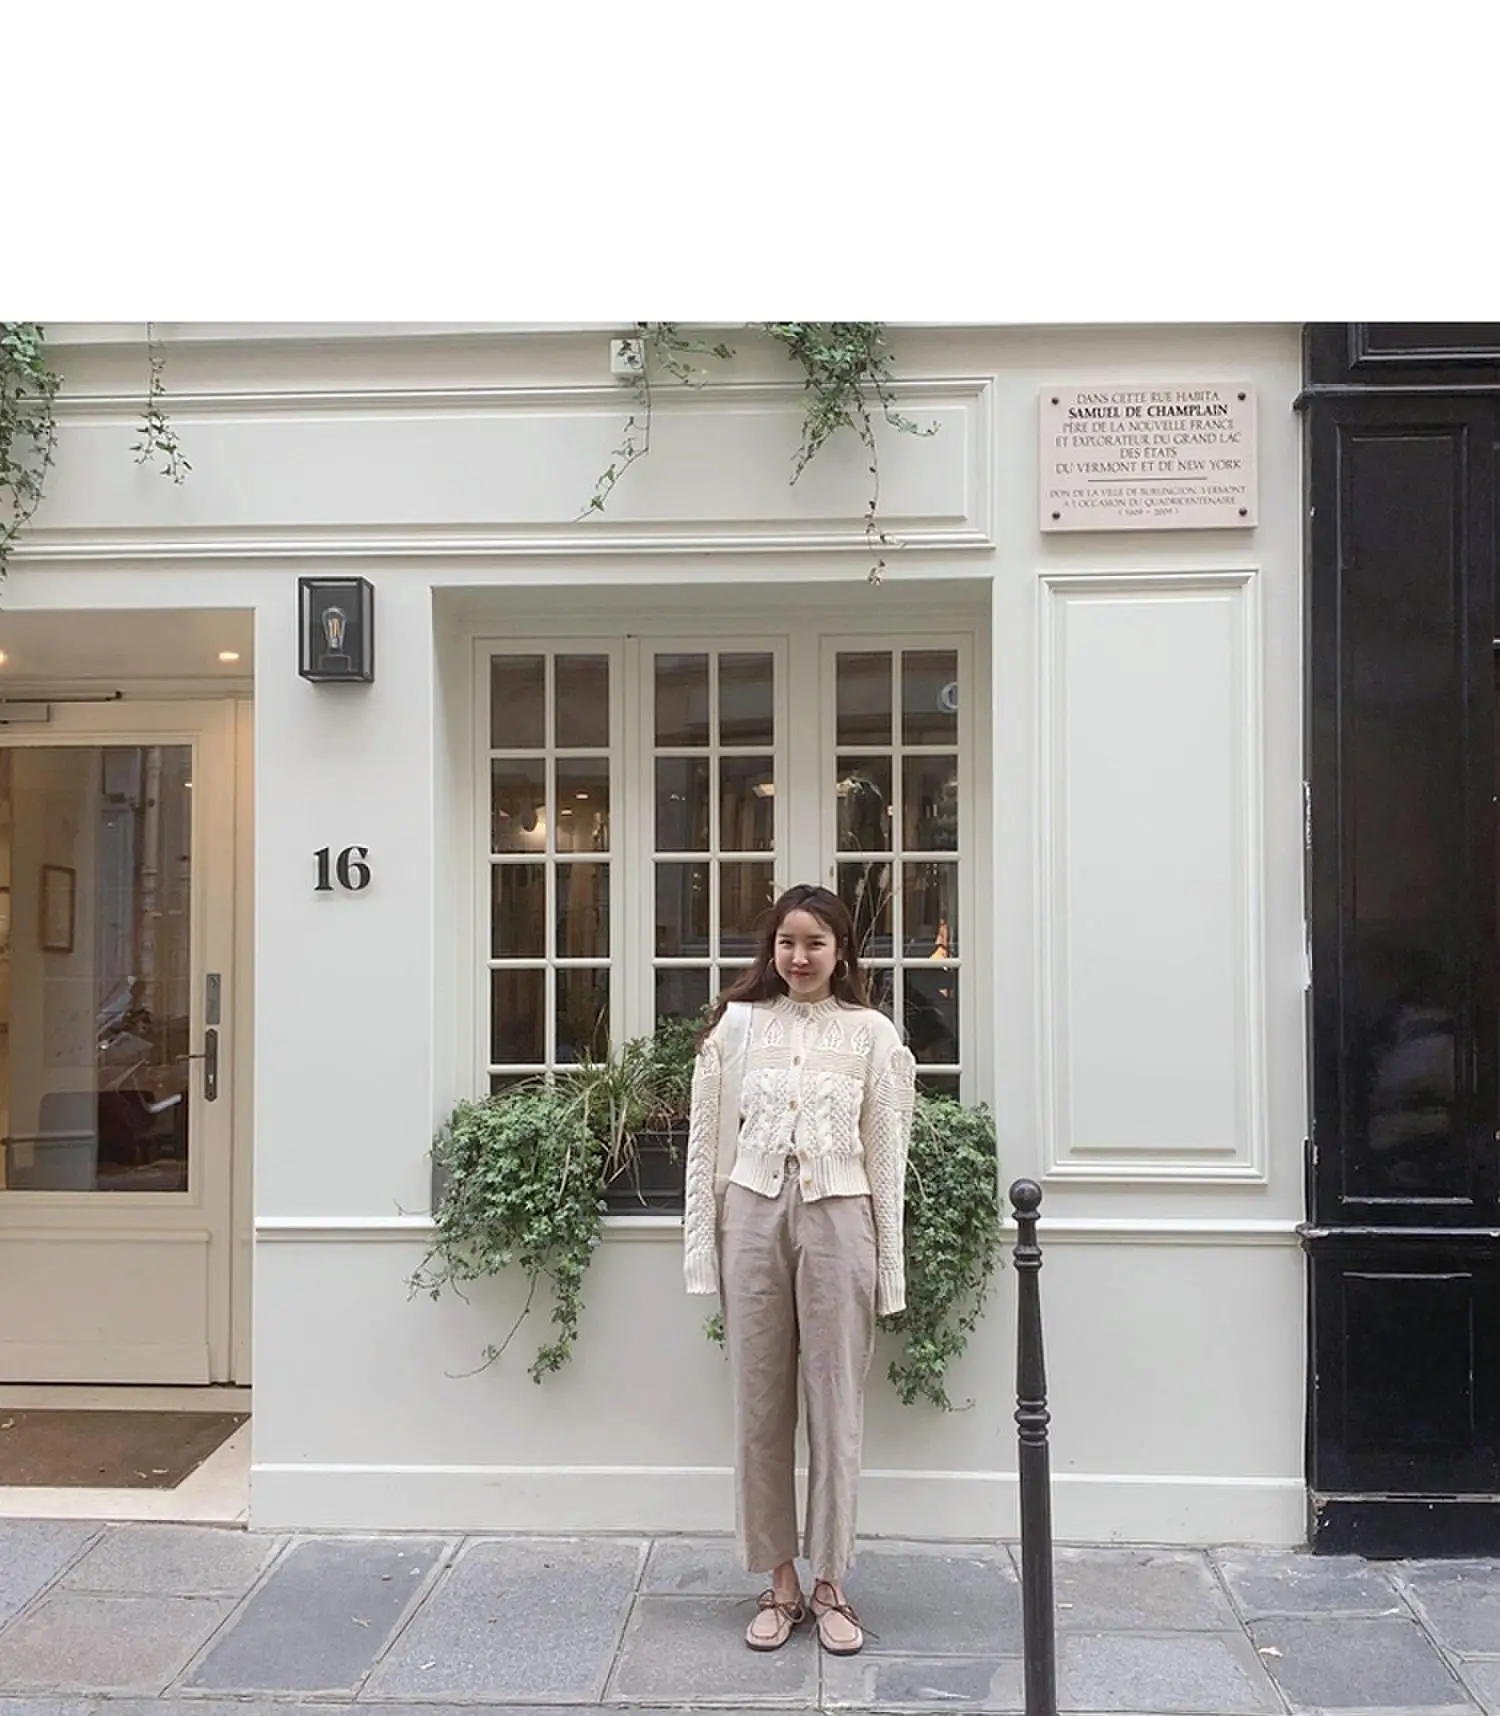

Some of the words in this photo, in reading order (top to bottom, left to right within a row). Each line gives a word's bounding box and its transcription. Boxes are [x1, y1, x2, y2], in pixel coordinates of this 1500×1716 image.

[1068, 407, 1120, 418] SAMUEL
[1125, 406, 1142, 417] DE
[1147, 404, 1228, 417] CHAMPLAIN
[1120, 448, 1141, 459] DES
[1055, 463, 1073, 474] DU
[1076, 462, 1137, 473] VERMONT
[1141, 461, 1154, 471] ET
[1158, 460, 1172, 471] DE
[1177, 460, 1205, 470] NEW
[1209, 459, 1241, 470] YORK
[313, 846, 371, 891] 16
